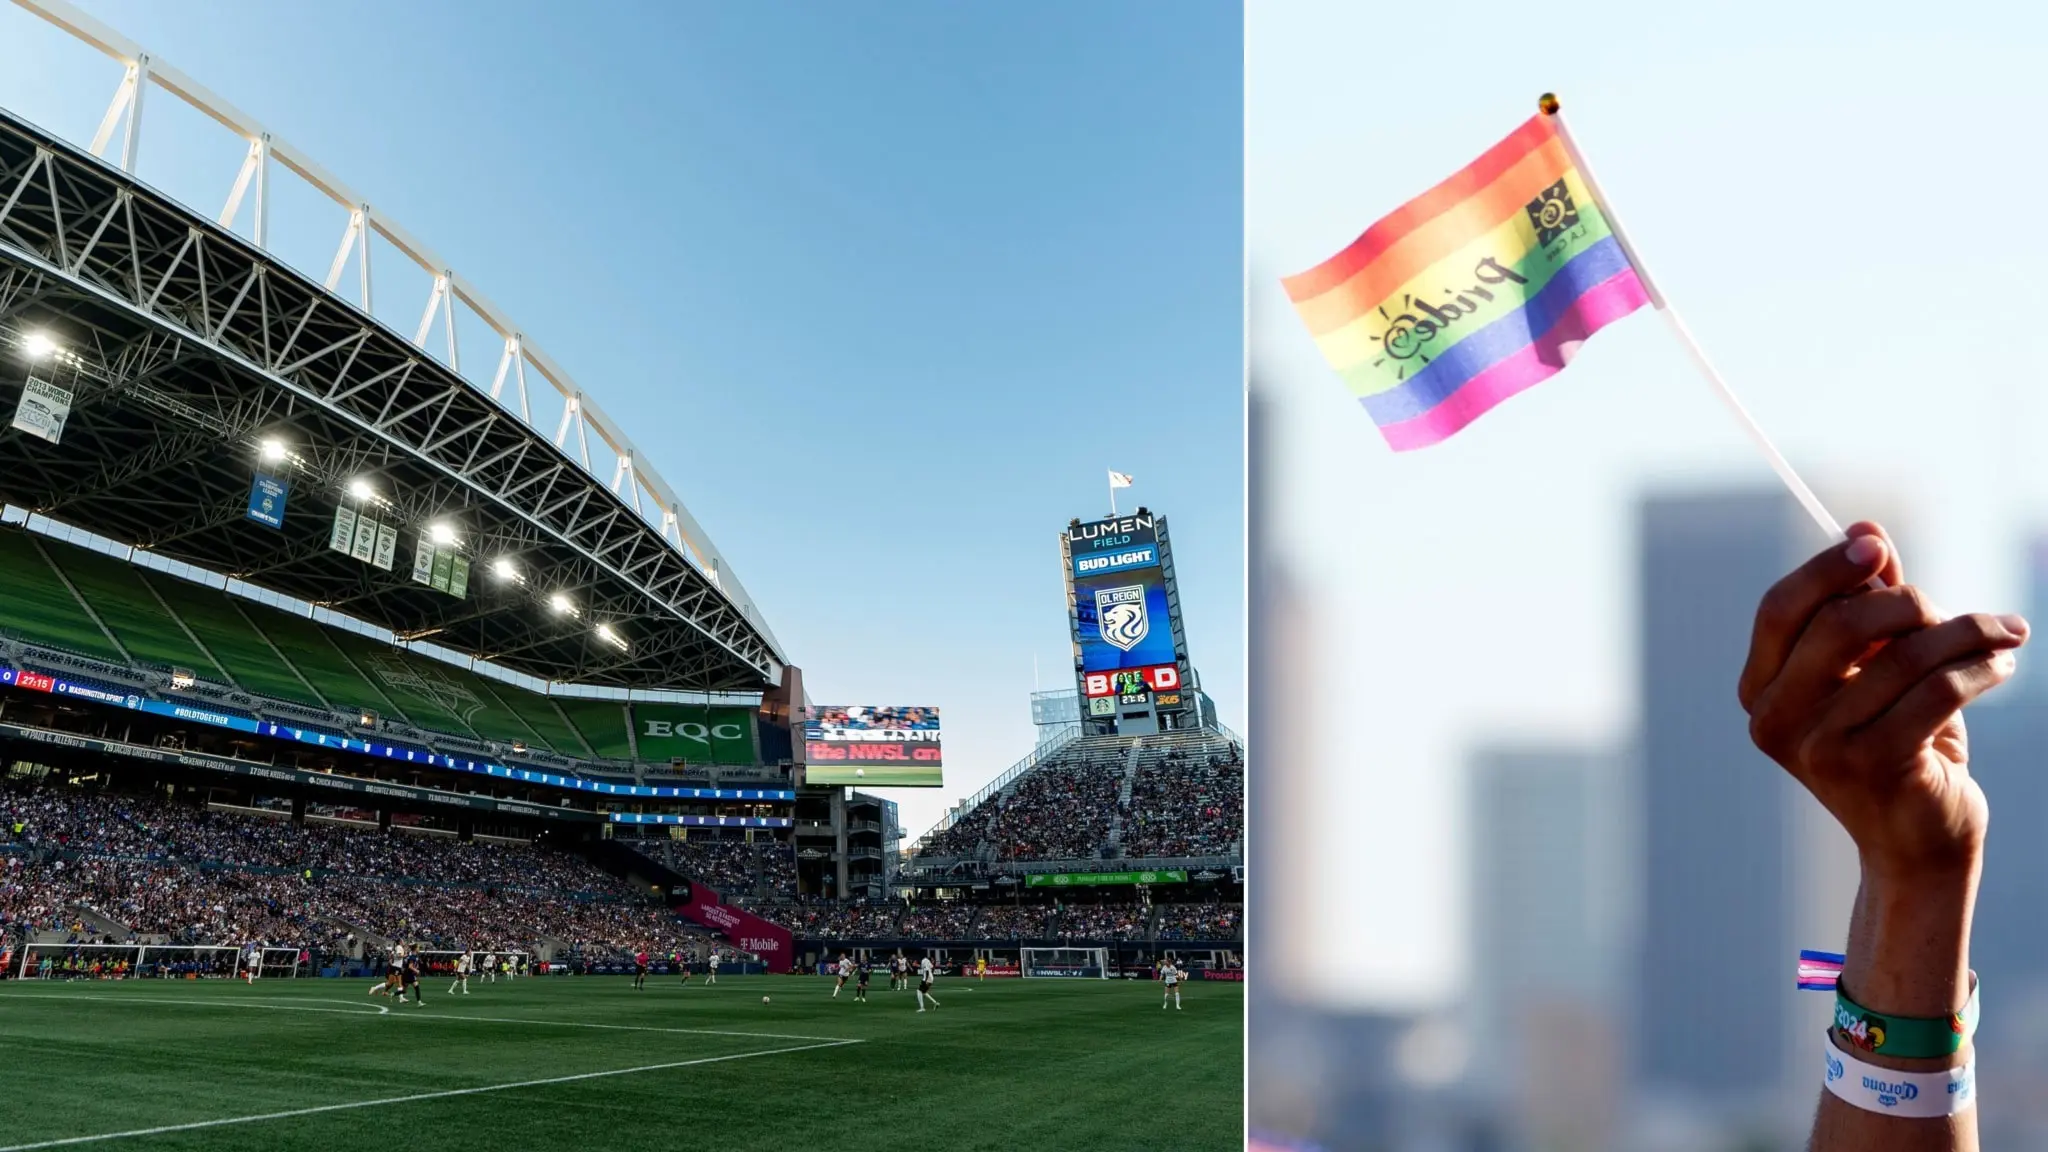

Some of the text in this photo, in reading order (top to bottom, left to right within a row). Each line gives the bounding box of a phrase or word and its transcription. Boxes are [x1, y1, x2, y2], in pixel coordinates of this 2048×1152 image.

[26, 384, 70, 407] CHAMPIONS
[29, 377, 72, 400] 2013 WORLD
[1069, 515, 1154, 541] LUMEN
[1094, 535, 1131, 548] FIELD
[1079, 550, 1152, 571] BUD LIGHT
[1101, 590, 1139, 604] OL REIGN
[3, 671, 125, 704] 0 27:15 0 WASHINGTON SPIRIT
[1086, 668, 1177, 695] BD
[1121, 694, 1146, 704] 27:15
[174, 707, 229, 725] #BOLDTOGETHER
[29, 731, 45, 742] PAUL
[54, 734, 73, 746] ALLEN
[643, 719, 743, 745] EQC
[103, 743, 113, 752] 79
[812, 743, 846, 760] the
[849, 743, 910, 761] NWSL
[179, 755, 189, 764] 45
[188, 756, 206, 767] KENNY
[206, 759, 225, 770] EASLEY
[249, 766, 258, 775] 17
[749, 937, 779, 951] Mobile
[1204, 970, 1244, 981] Proud p
[1862, 1075, 1919, 1101] Corona
